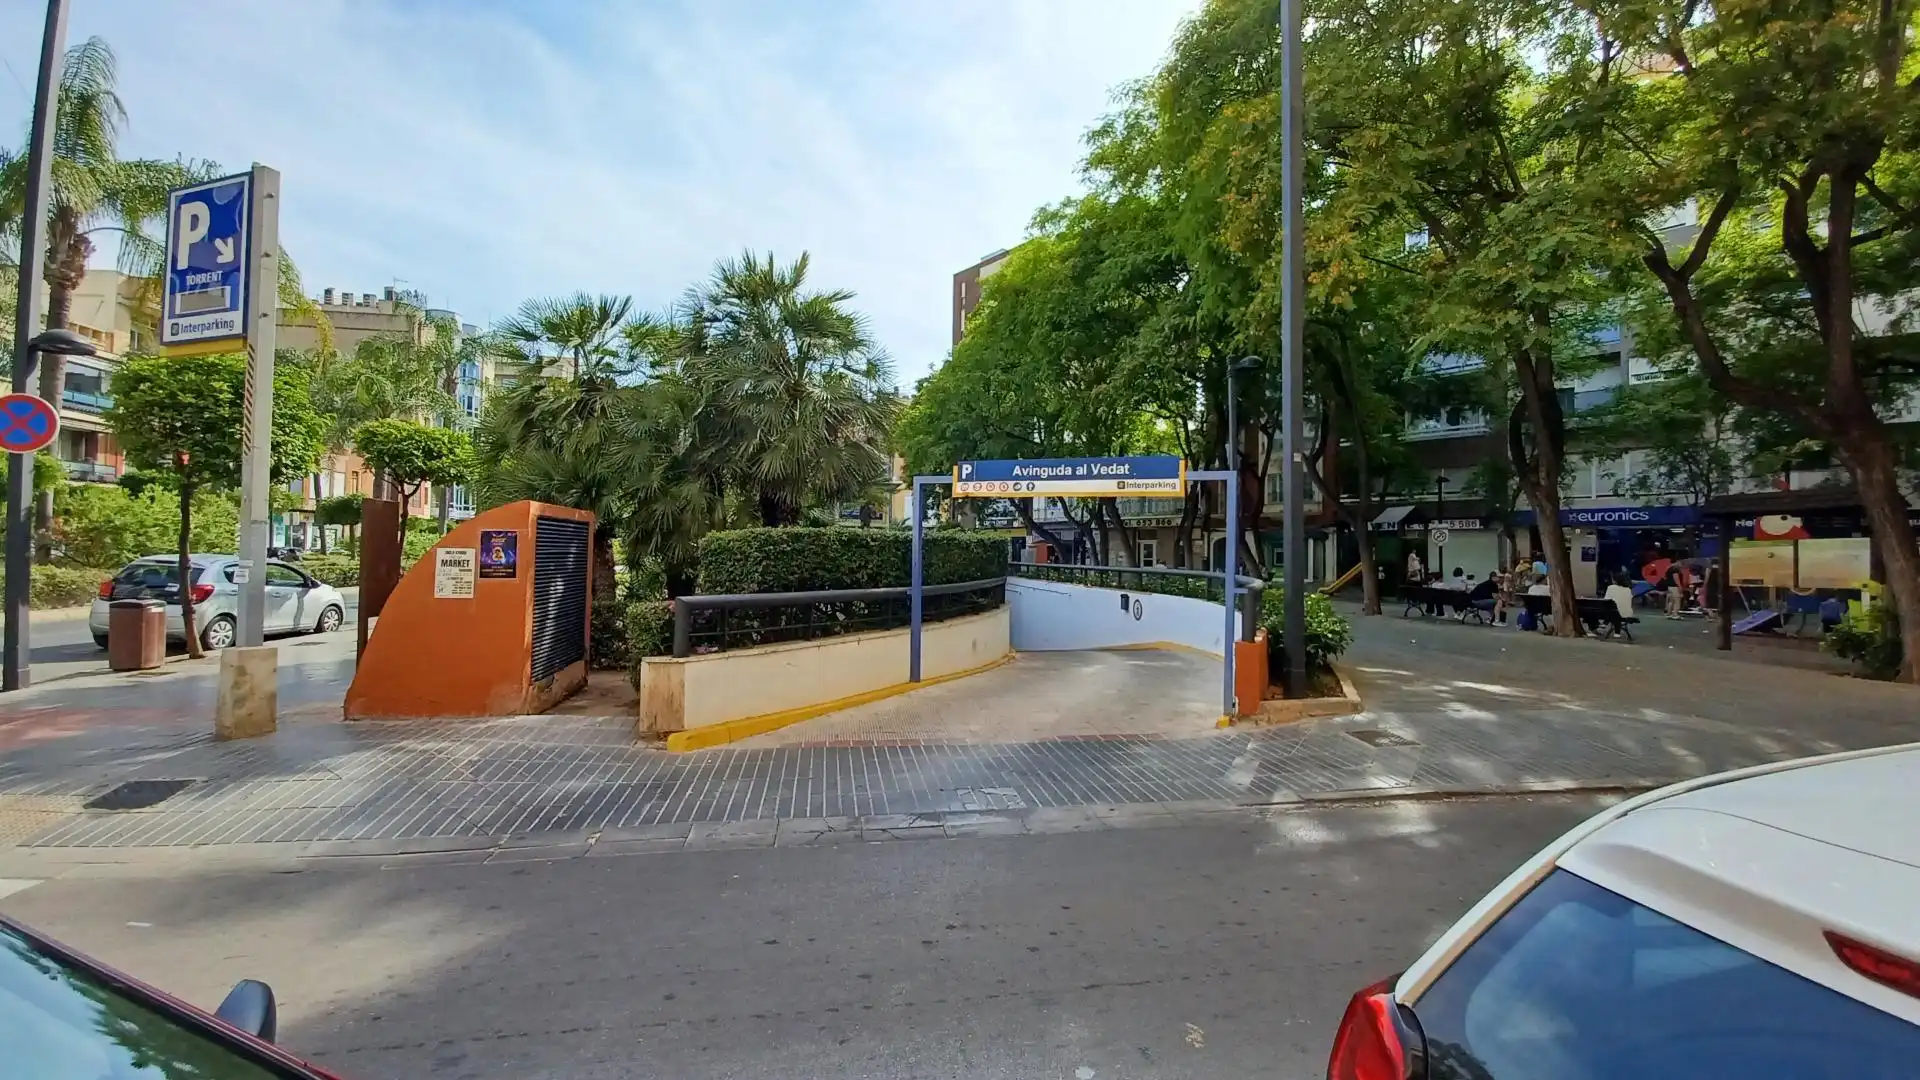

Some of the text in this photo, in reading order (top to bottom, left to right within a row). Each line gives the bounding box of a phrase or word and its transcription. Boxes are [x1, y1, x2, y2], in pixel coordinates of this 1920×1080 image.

[176, 201, 210, 270] P
[185, 271, 224, 286] TORRENT
[180, 319, 234, 335] Interparking
[961, 463, 1130, 479] P Avinguda al Vedat
[1126, 481, 1177, 490] Interparking
[1577, 509, 1649, 522] euronics
[440, 559, 470, 568] MARKET
